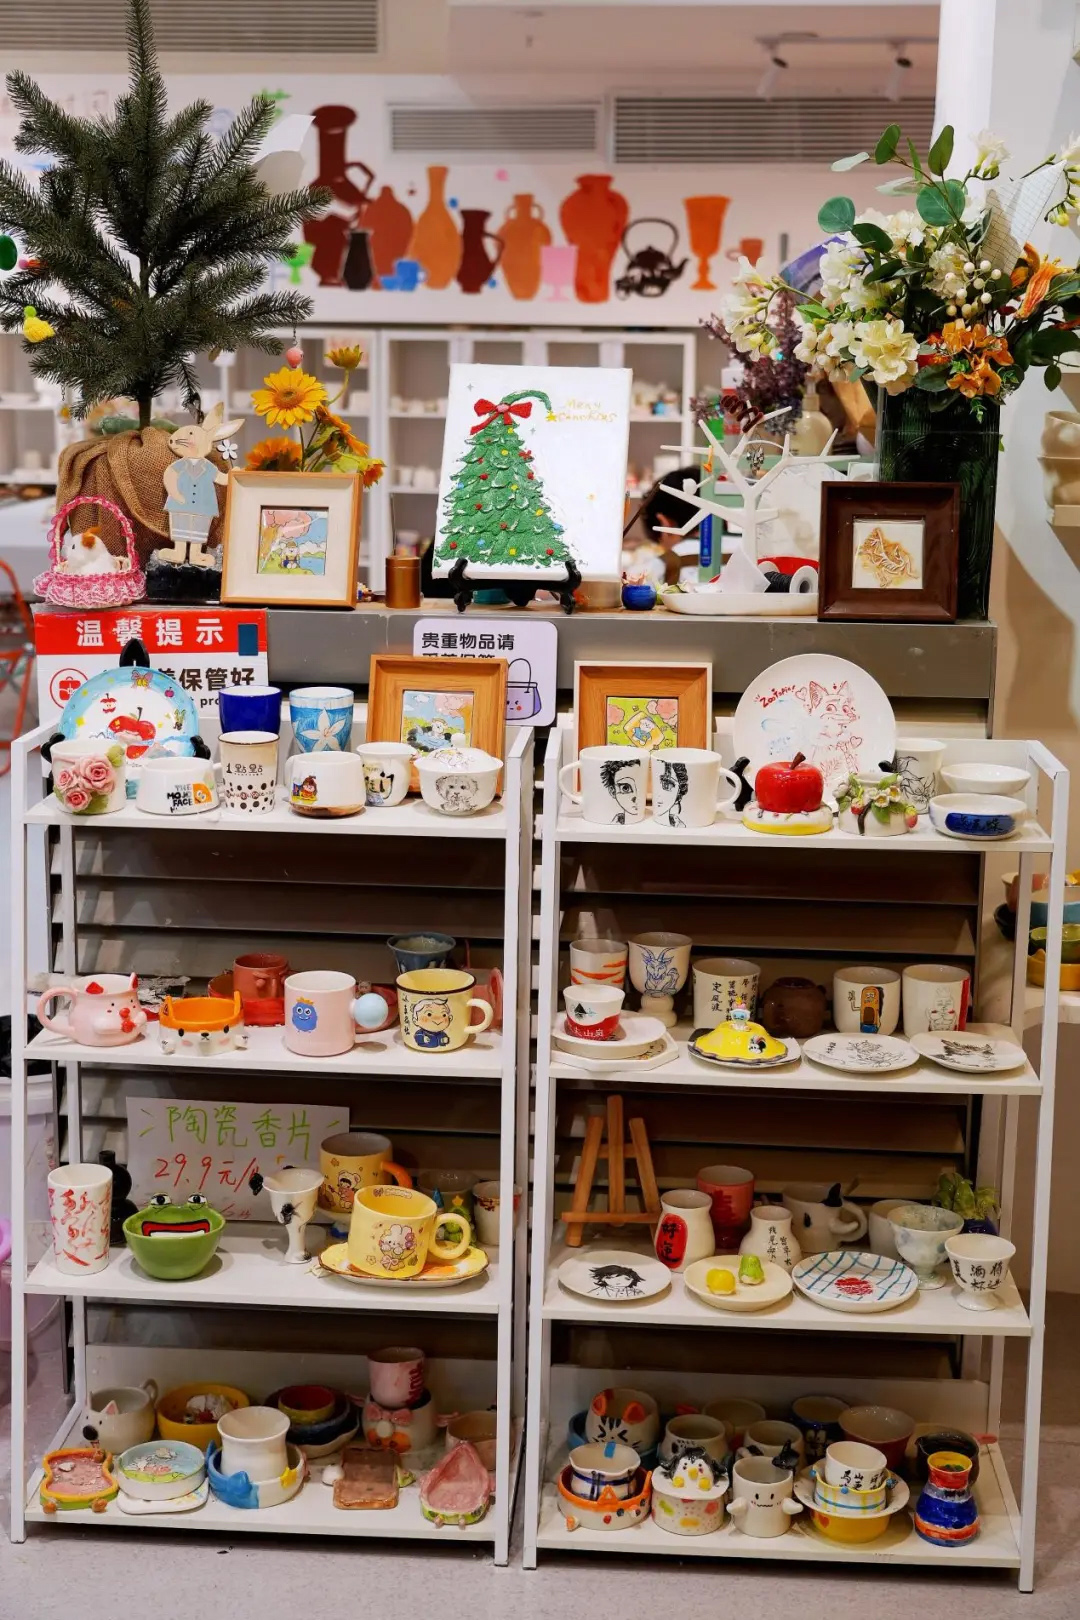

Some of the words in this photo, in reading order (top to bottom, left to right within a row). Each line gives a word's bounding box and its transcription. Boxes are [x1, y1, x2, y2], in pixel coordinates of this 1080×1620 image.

[76, 617, 224, 647] 温馨提示
[421, 632, 515, 650] 贵重物品请
[166, 1105, 312, 1161] 陶瓷香片
